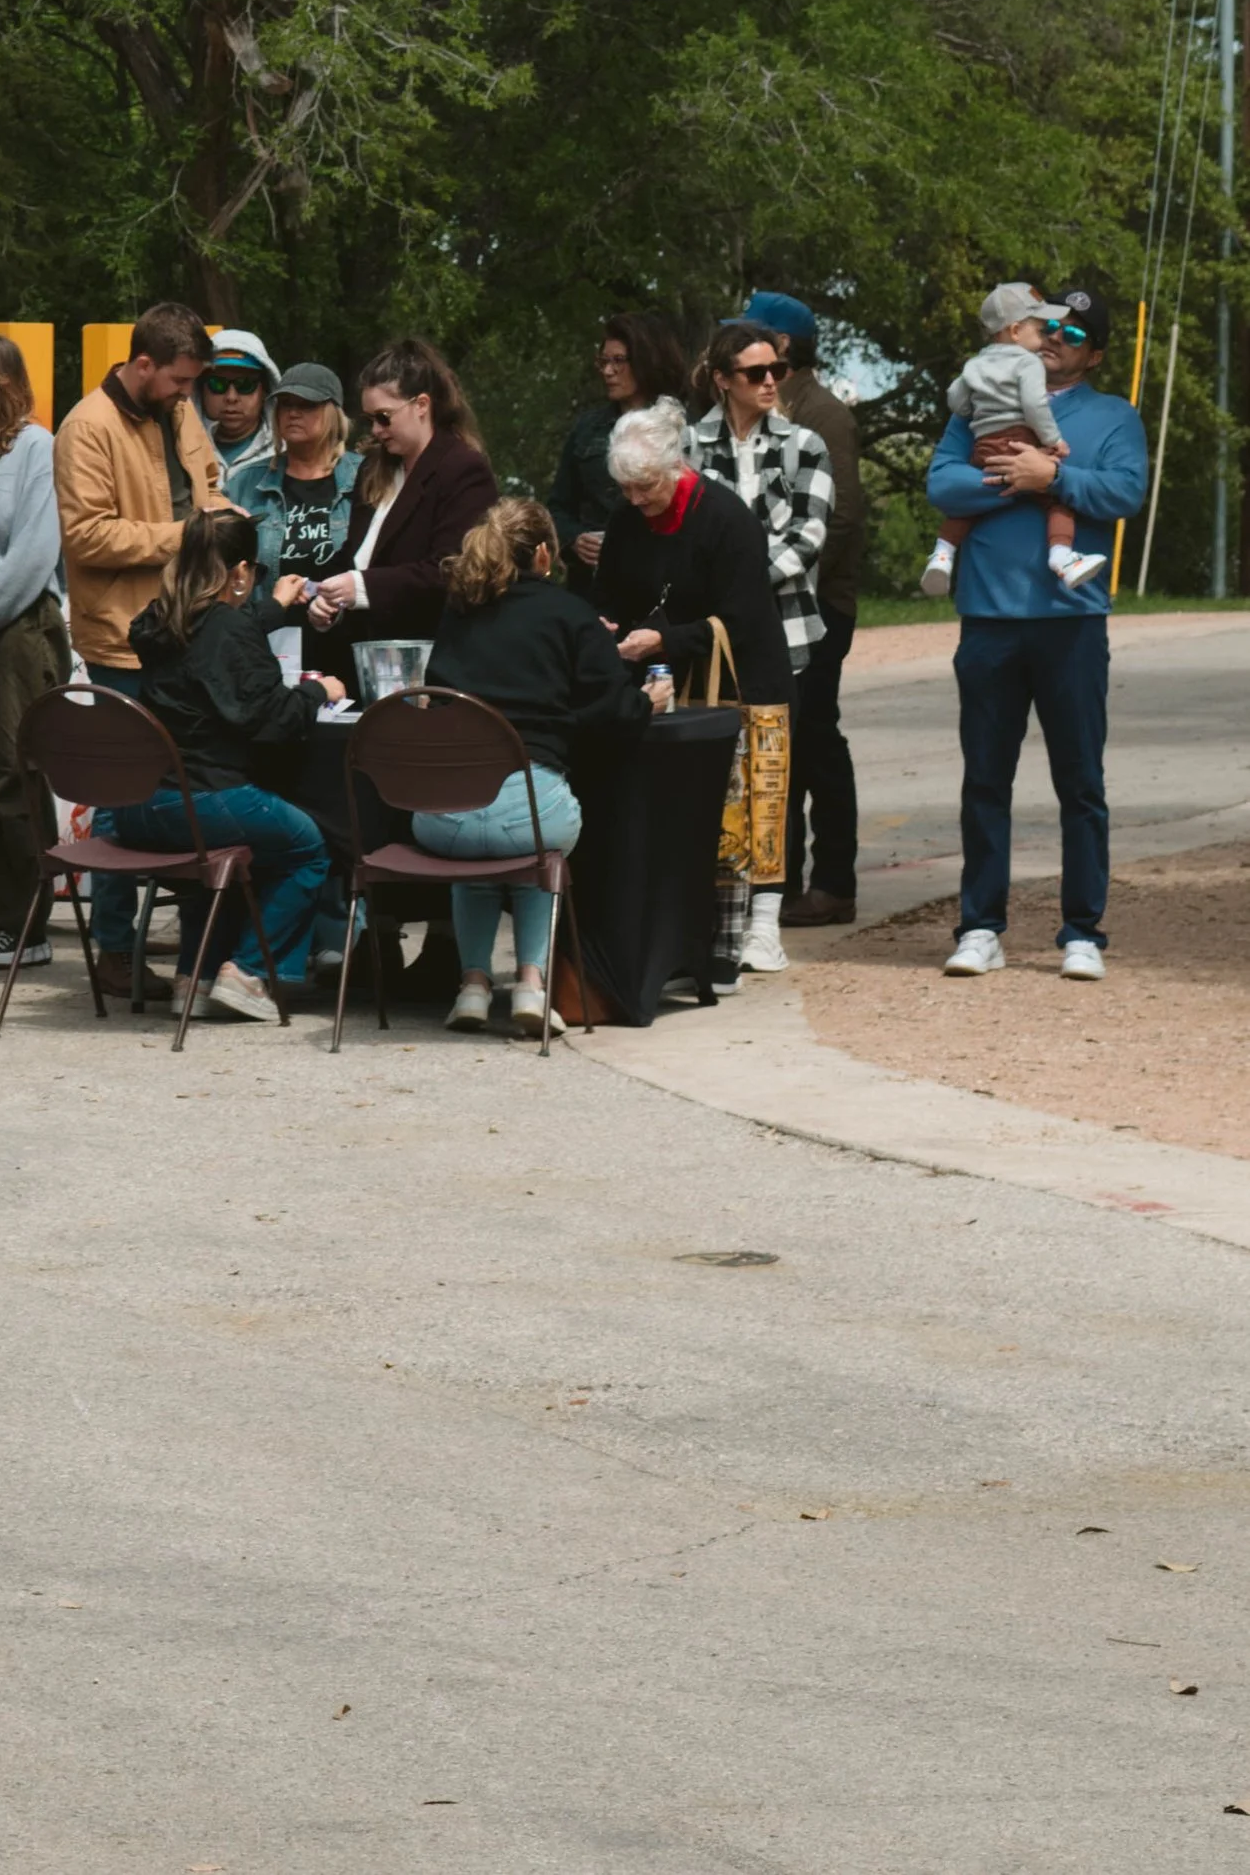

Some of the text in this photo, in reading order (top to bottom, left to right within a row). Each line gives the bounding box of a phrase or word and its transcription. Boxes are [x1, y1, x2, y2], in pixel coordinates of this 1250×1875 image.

[286, 503, 332, 524] ffee
[298, 523, 329, 540] SWE
[312, 540, 336, 565] D
